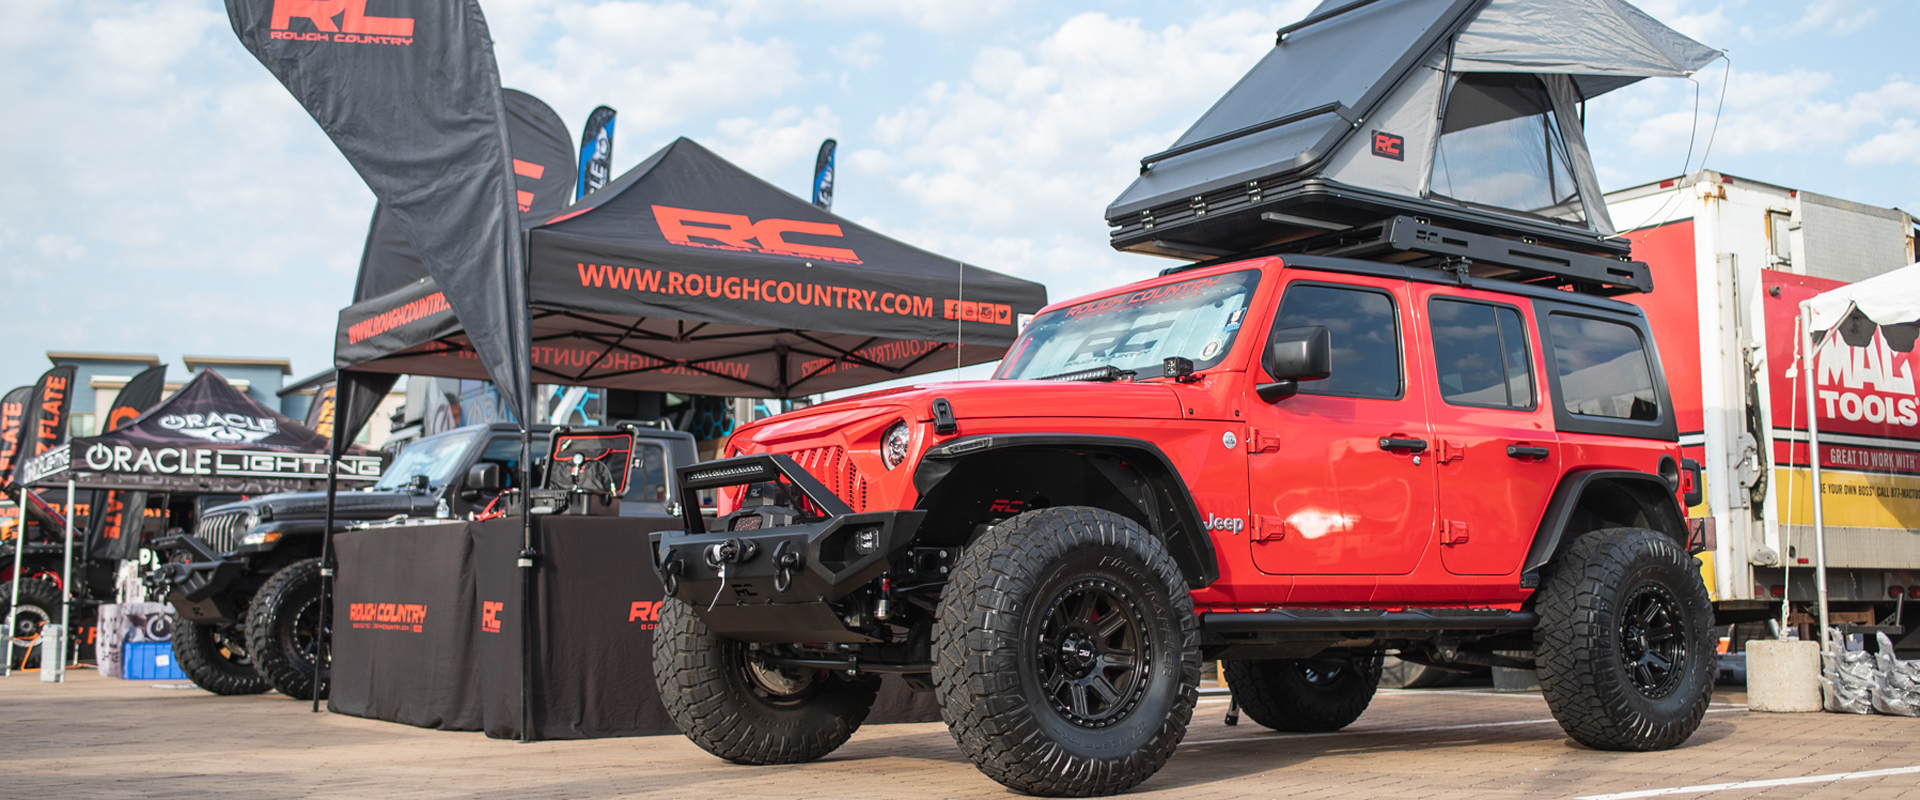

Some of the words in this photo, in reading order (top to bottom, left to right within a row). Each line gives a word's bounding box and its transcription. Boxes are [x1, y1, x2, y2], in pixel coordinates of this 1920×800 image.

[270, 31, 329, 41] ROUGH
[334, 34, 414, 46] COUNTRY
[1375, 134, 1401, 155] RC
[651, 205, 859, 260] RC
[577, 262, 934, 318] WWW.ROUGHCOUNTRY.COM
[1065, 294, 1129, 318] ROUGH
[1128, 276, 1223, 304] COUNTRY
[1817, 324, 1916, 396] MAC
[37, 375, 67, 439] FLATE
[1819, 389, 1918, 427] TOOLS
[158, 411, 279, 434] ORACLE
[85, 442, 213, 476] ORACLE
[216, 455, 382, 477] LIGHTING
[1830, 448, 1857, 466] GREAT
[1859, 450, 1869, 466] TO
[1871, 452, 1895, 468] WORK
[1895, 454, 1915, 470] WITH
[1828, 483, 1843, 495] YOUR
[1844, 484, 1857, 496] OWN
[1859, 485, 1873, 497] BOSS
[1877, 486, 1890, 498] CALL
[990, 499, 1024, 513] RC
[1203, 512, 1244, 535] Jeep
[350, 603, 377, 621] ROUGH
[377, 603, 427, 624] COUNTRY
[482, 600, 504, 629] RC
[629, 600, 663, 622] RC
